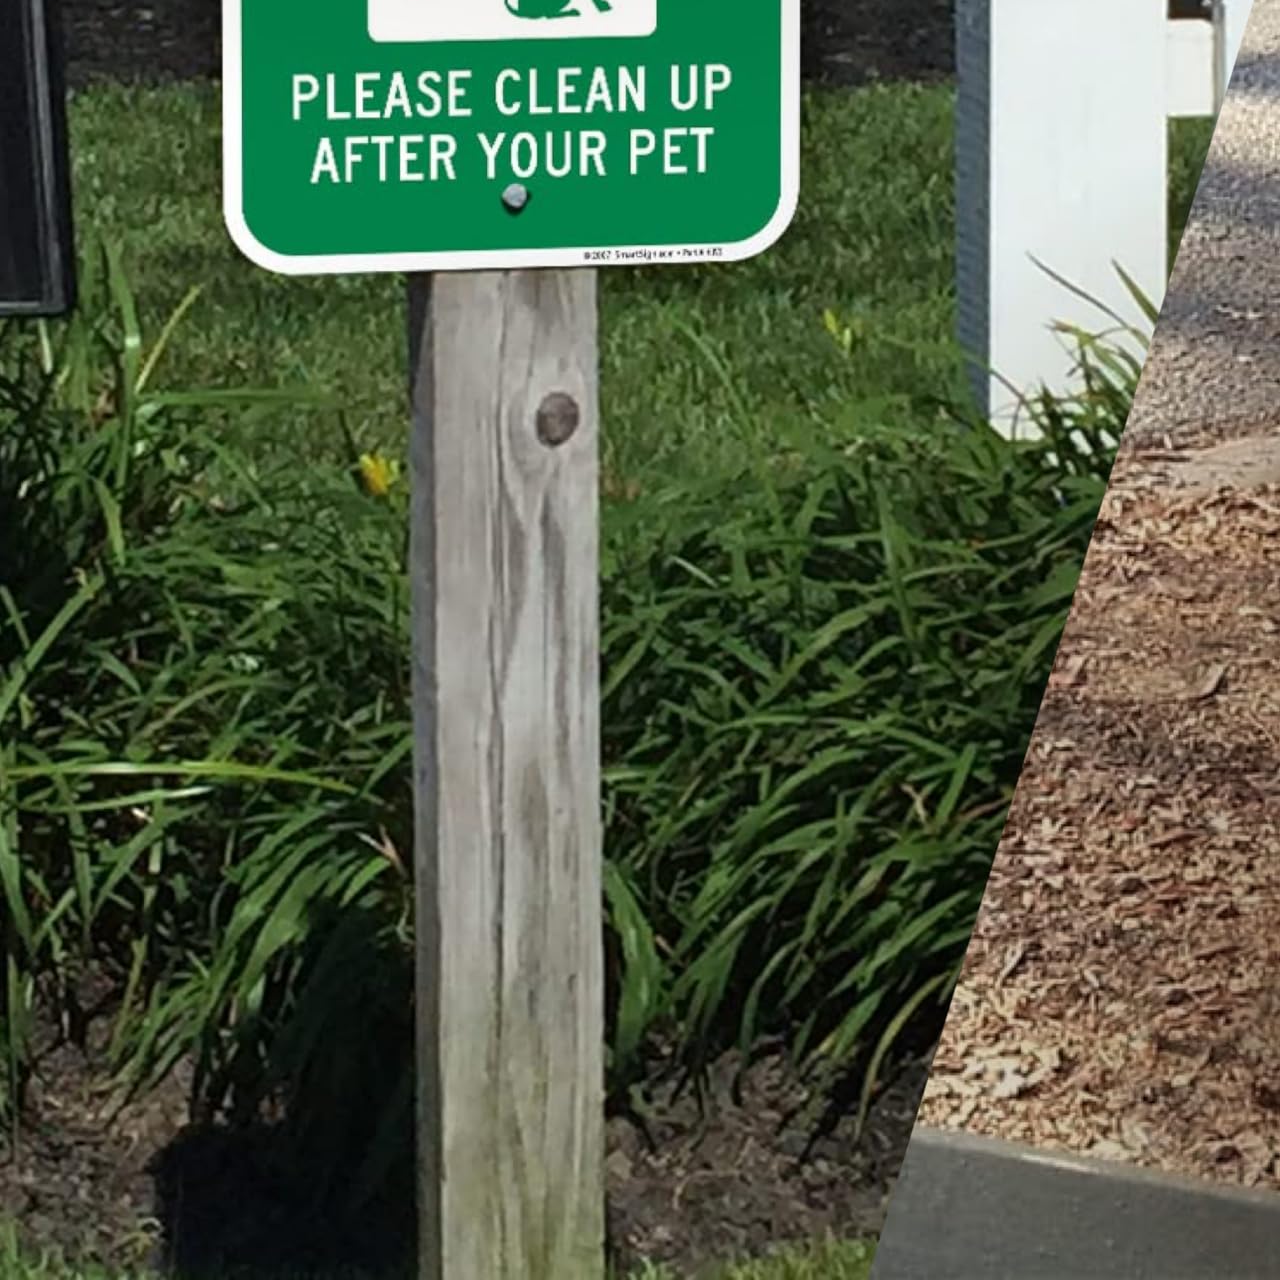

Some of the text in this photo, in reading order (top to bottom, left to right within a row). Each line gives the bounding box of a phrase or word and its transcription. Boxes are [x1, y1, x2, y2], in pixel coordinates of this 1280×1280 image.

[293, 63, 732, 120] PLEASE CLEAN UP
[310, 127, 714, 184] AFTER YOUR PET
